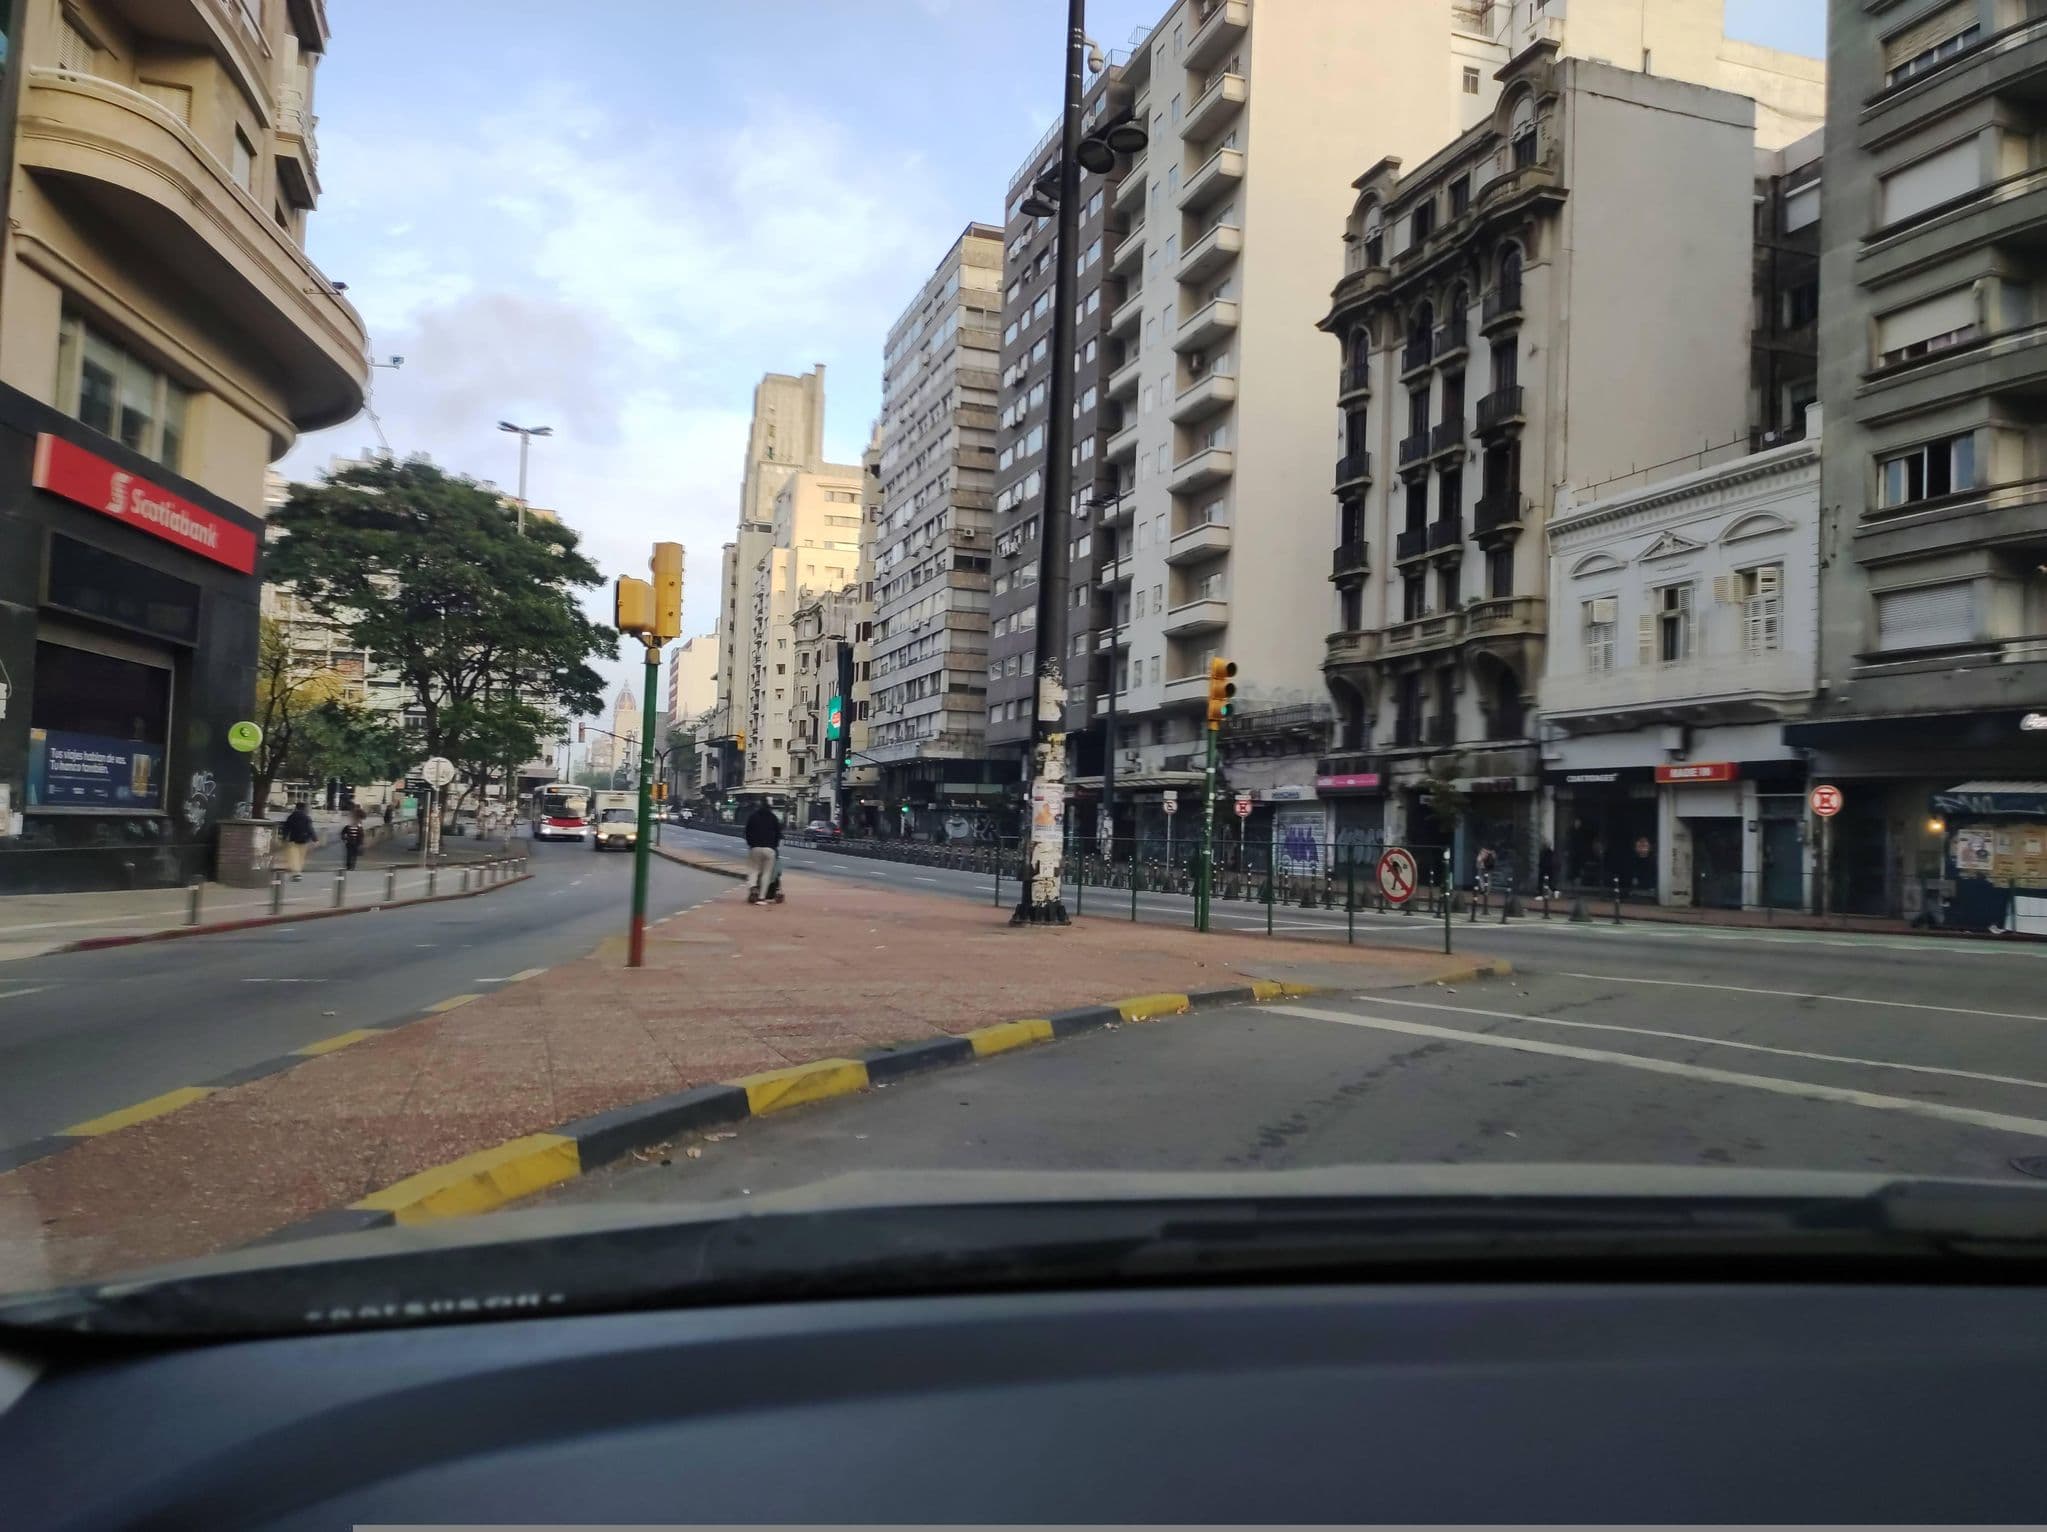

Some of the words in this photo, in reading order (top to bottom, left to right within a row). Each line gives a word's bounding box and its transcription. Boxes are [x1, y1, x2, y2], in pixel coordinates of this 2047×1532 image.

[130, 488, 218, 549] Scotiabank
[50, 747, 64, 759] Tus
[64, 748, 84, 762] viajes
[106, 753, 115, 764] de
[50, 759, 60, 771] Tu
